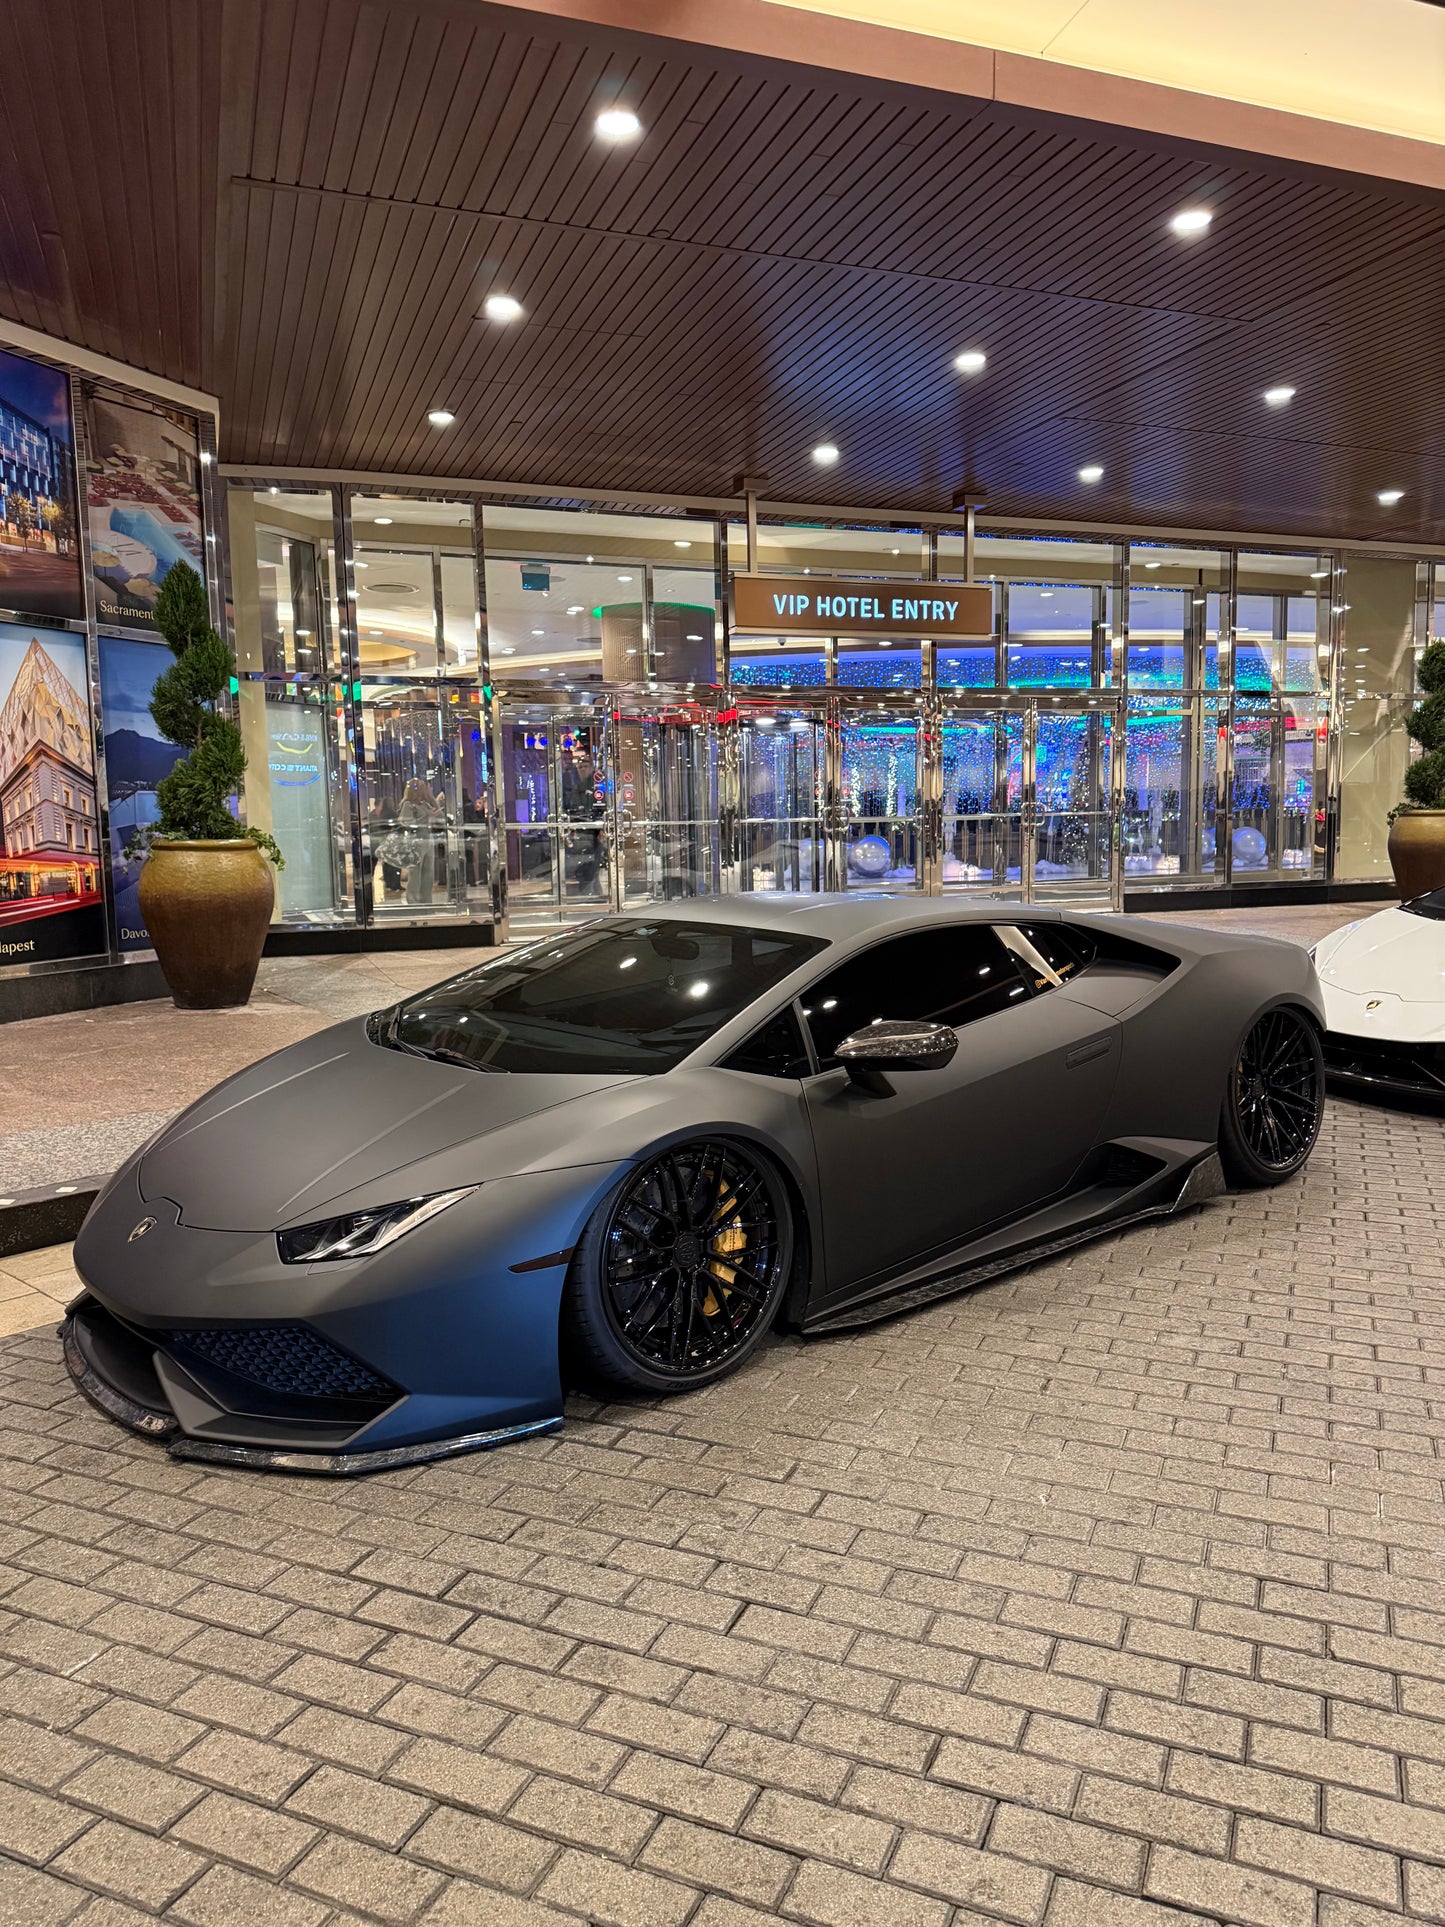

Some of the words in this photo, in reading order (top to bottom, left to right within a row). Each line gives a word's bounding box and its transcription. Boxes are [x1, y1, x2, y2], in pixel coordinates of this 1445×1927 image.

[100, 600, 155, 620] Sacrament
[773, 594, 810, 615] VIP
[816, 596, 885, 618] HOTEL
[891, 599, 959, 621] ENTRY
[121, 928, 150, 940] Davo
